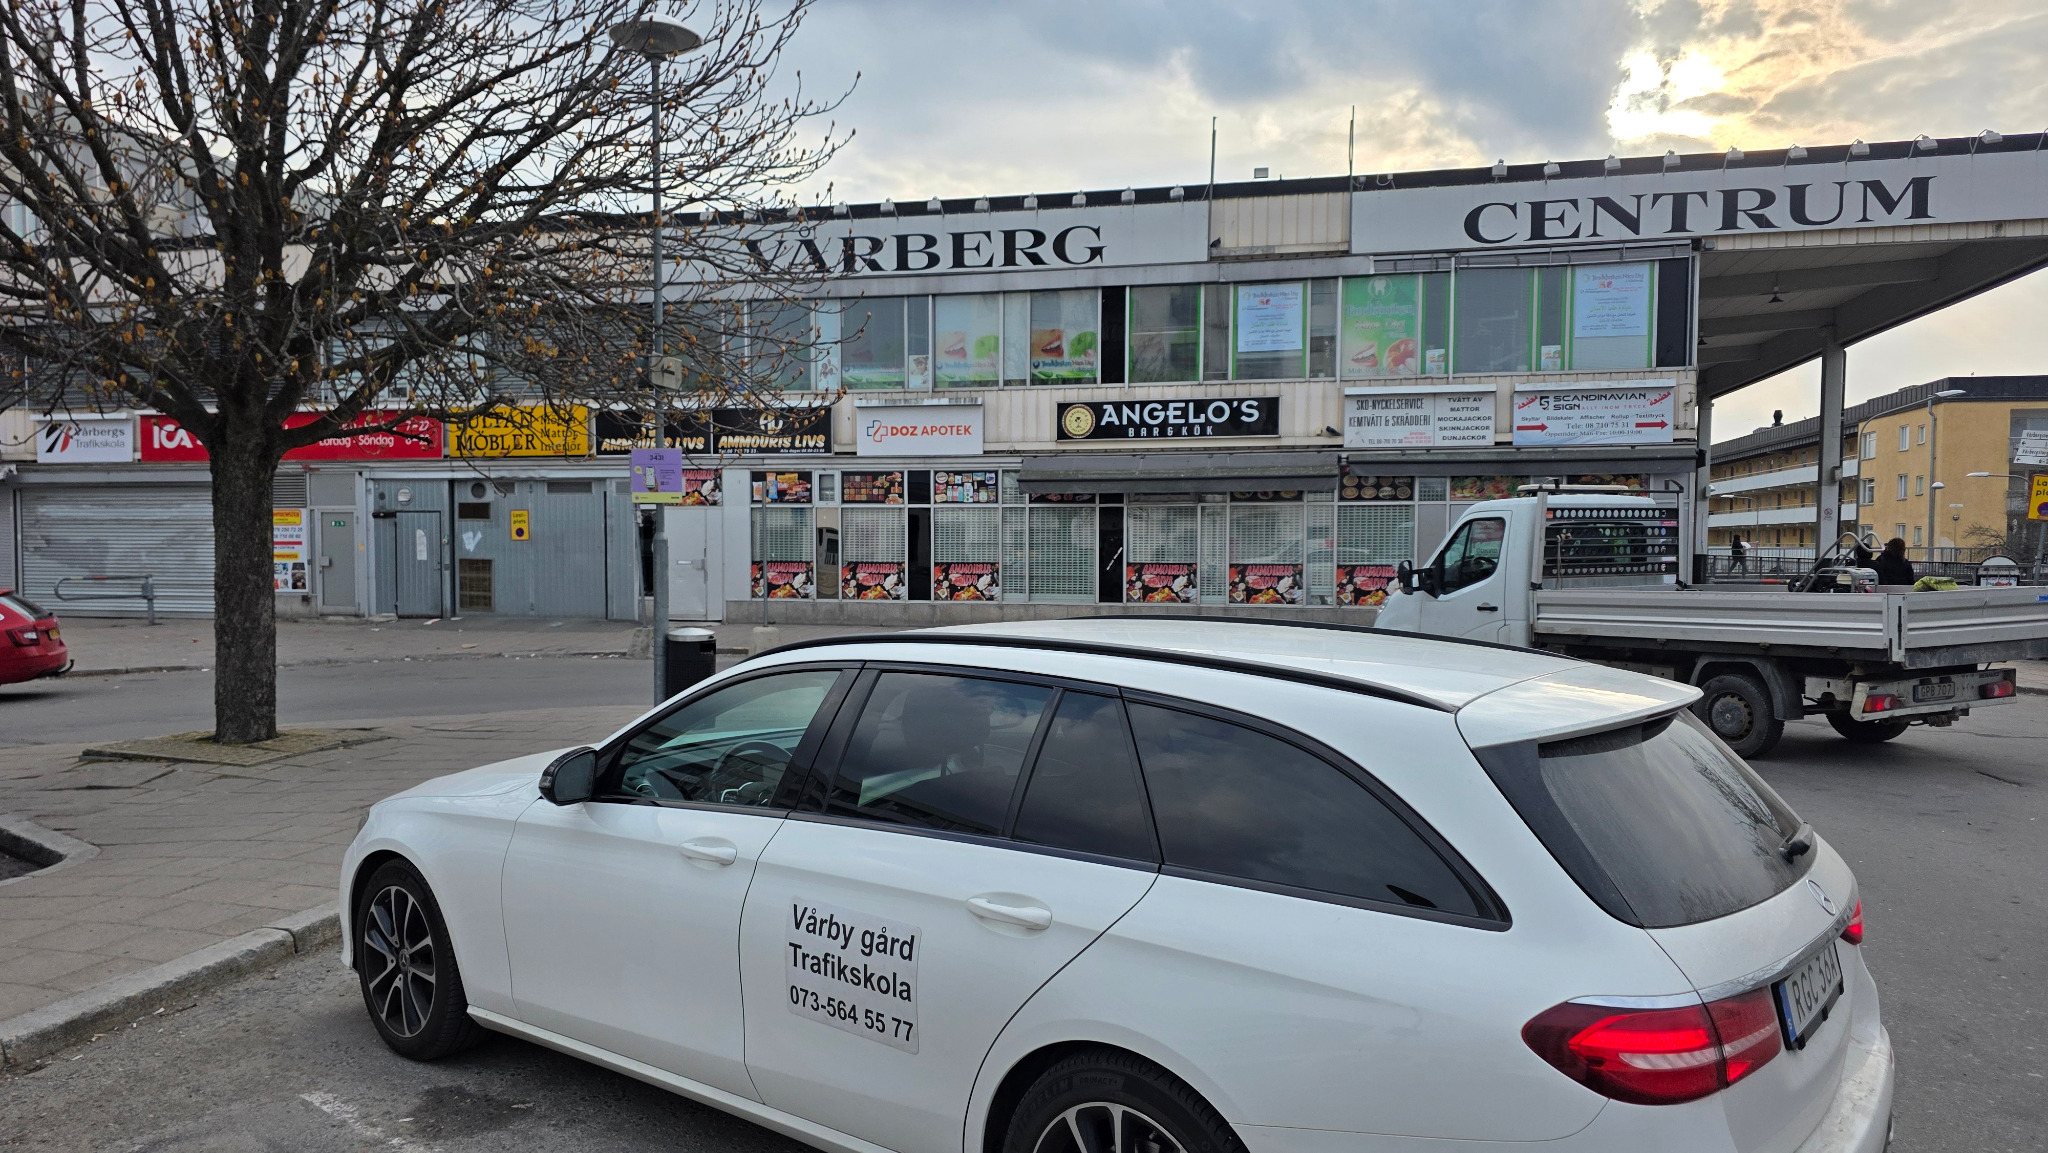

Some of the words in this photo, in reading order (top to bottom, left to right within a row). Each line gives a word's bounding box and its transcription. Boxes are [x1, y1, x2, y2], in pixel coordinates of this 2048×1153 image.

[1463, 175, 1938, 244] CENTRUM
[744, 225, 1107, 274] VÅRBERG
[1553, 392, 1646, 402] SCANDINAVIAN
[1101, 400, 1260, 426] ANGELO'S
[1553, 403, 1580, 411] SIGN
[1349, 413, 1383, 427] KEMTVÄTT
[1392, 412, 1430, 427] SKRÄDDERI
[75, 427, 125, 438] Vårbergs
[153, 424, 193, 448] ICA
[890, 426, 918, 436] DOZ
[921, 425, 972, 436] APOTEK
[75, 439, 125, 448] Trafikskola
[358, 434, 394, 447] Söndag
[456, 430, 538, 451] MÖBLER
[601, 436, 673, 451] AMMOURS
[675, 436, 705, 450] LIVS
[718, 434, 791, 448] AMMOURIS
[795, 434, 826, 448] LIVS
[1921, 685, 1934, 698] GPB
[1938, 684, 1952, 696] 707
[793, 903, 855, 950] Vårby
[860, 926, 915, 961] gård
[788, 941, 912, 1002] Trafikskola
[1791, 964, 1819, 1022] RGC
[790, 985, 858, 1025] 073-564
[864, 1008, 886, 1033] 55
[891, 1016, 914, 1042] 77
